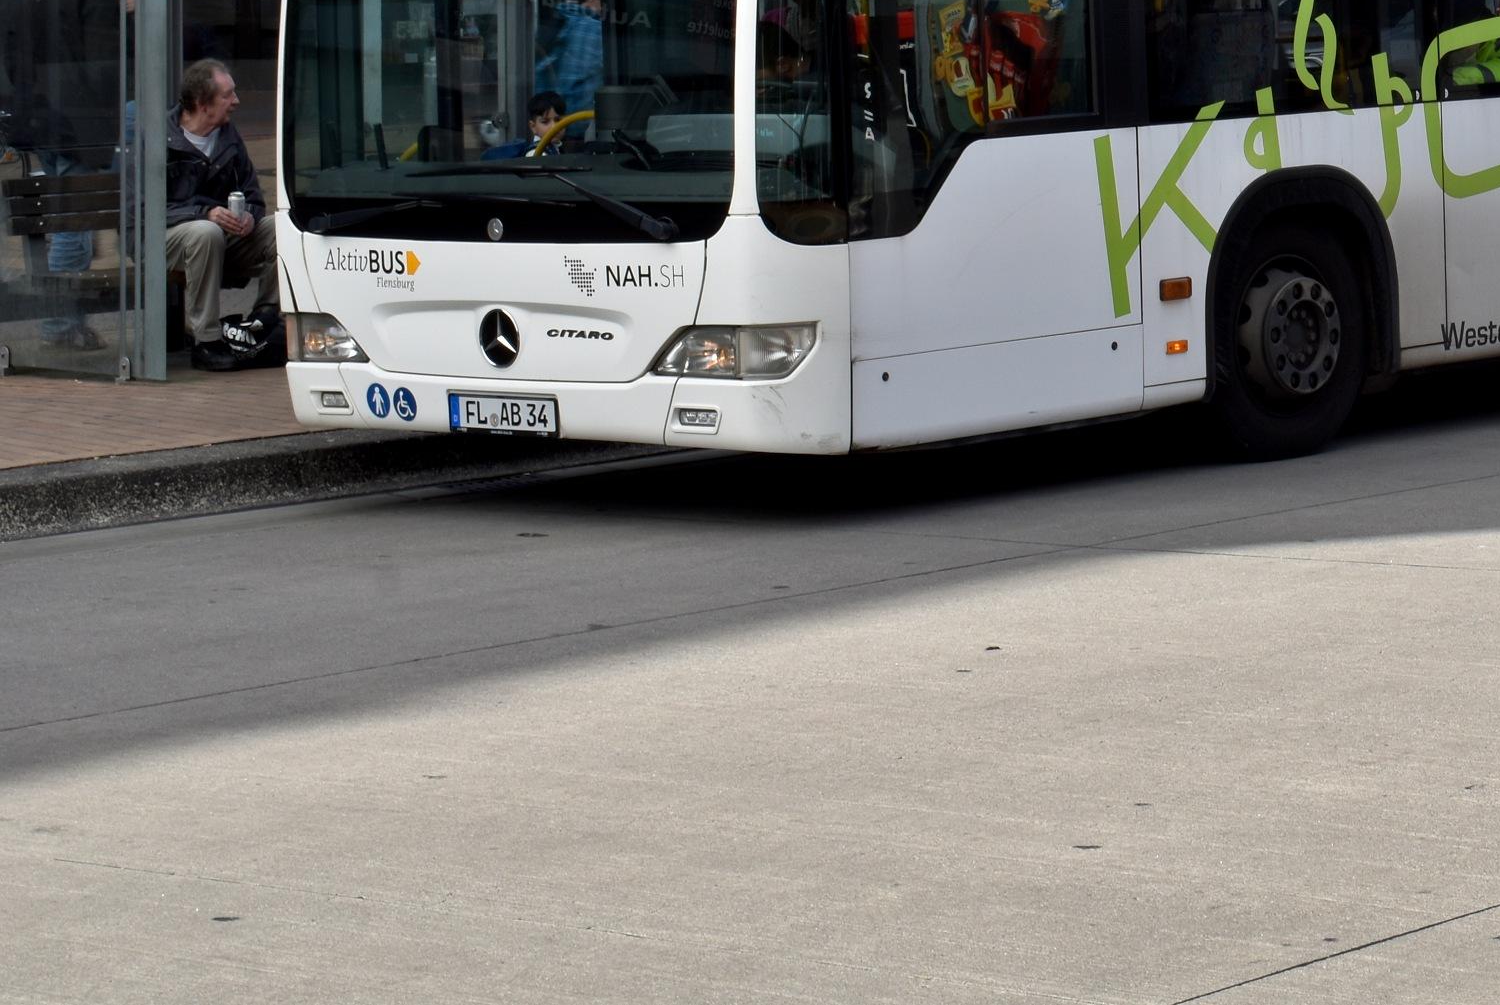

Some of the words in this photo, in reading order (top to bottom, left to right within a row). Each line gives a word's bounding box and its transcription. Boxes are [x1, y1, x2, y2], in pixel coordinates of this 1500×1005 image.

[324, 247, 406, 275] AktivBUS
[376, 276, 415, 293] Flensburg
[605, 264, 685, 288] NAH.SH
[546, 328, 615, 341] CITARO
[465, 400, 488, 425] FL
[500, 402, 522, 426] AB
[526, 403, 548, 428] 34
